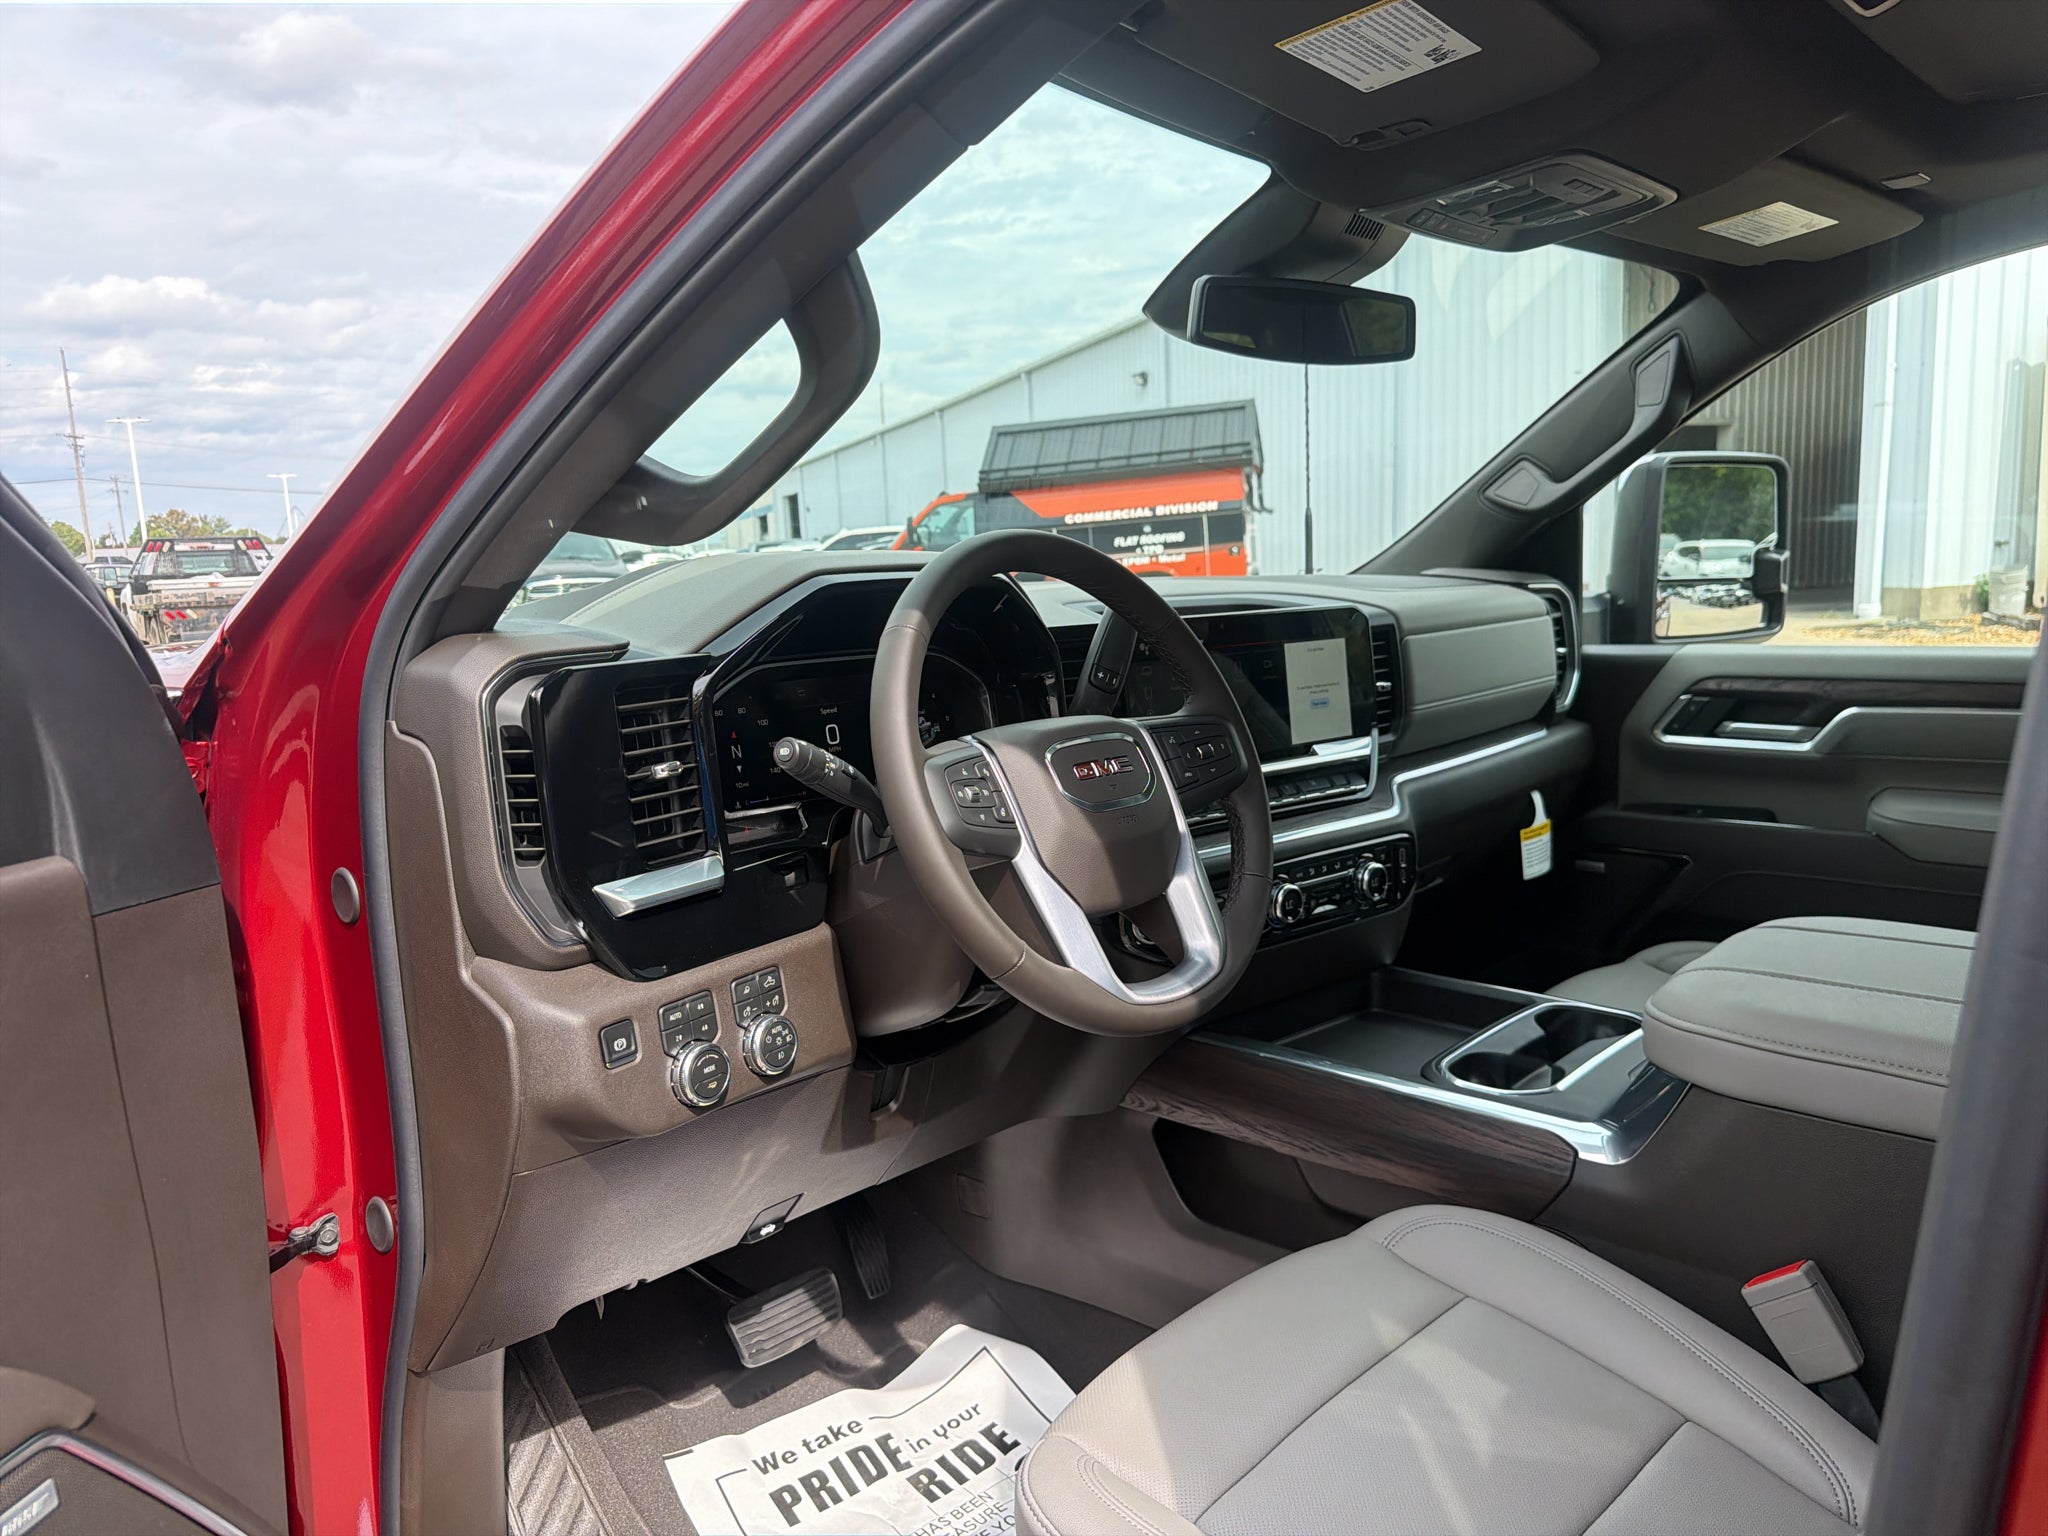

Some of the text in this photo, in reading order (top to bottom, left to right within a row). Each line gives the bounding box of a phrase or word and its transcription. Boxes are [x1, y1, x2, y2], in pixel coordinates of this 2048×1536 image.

[1064, 500, 1218, 524] COMMERCIAL DIVISION
[1113, 531, 1186, 547] FLAT ROOFING
[820, 706, 838, 715] Speed
[731, 744, 742, 759] N
[1073, 757, 1133, 780] GMC
[669, 1011, 682, 1021] AUTO
[771, 1025, 782, 1035] AUTO
[703, 1064, 716, 1074] MODE
[751, 1420, 864, 1475] We take
[768, 1403, 980, 1527] PRIDE in your
[906, 1421, 1021, 1504] RIDE
[914, 1491, 994, 1536] HAS BEEN
[944, 1502, 1008, 1536] ASURE
[990, 1514, 1015, 1533] YO
